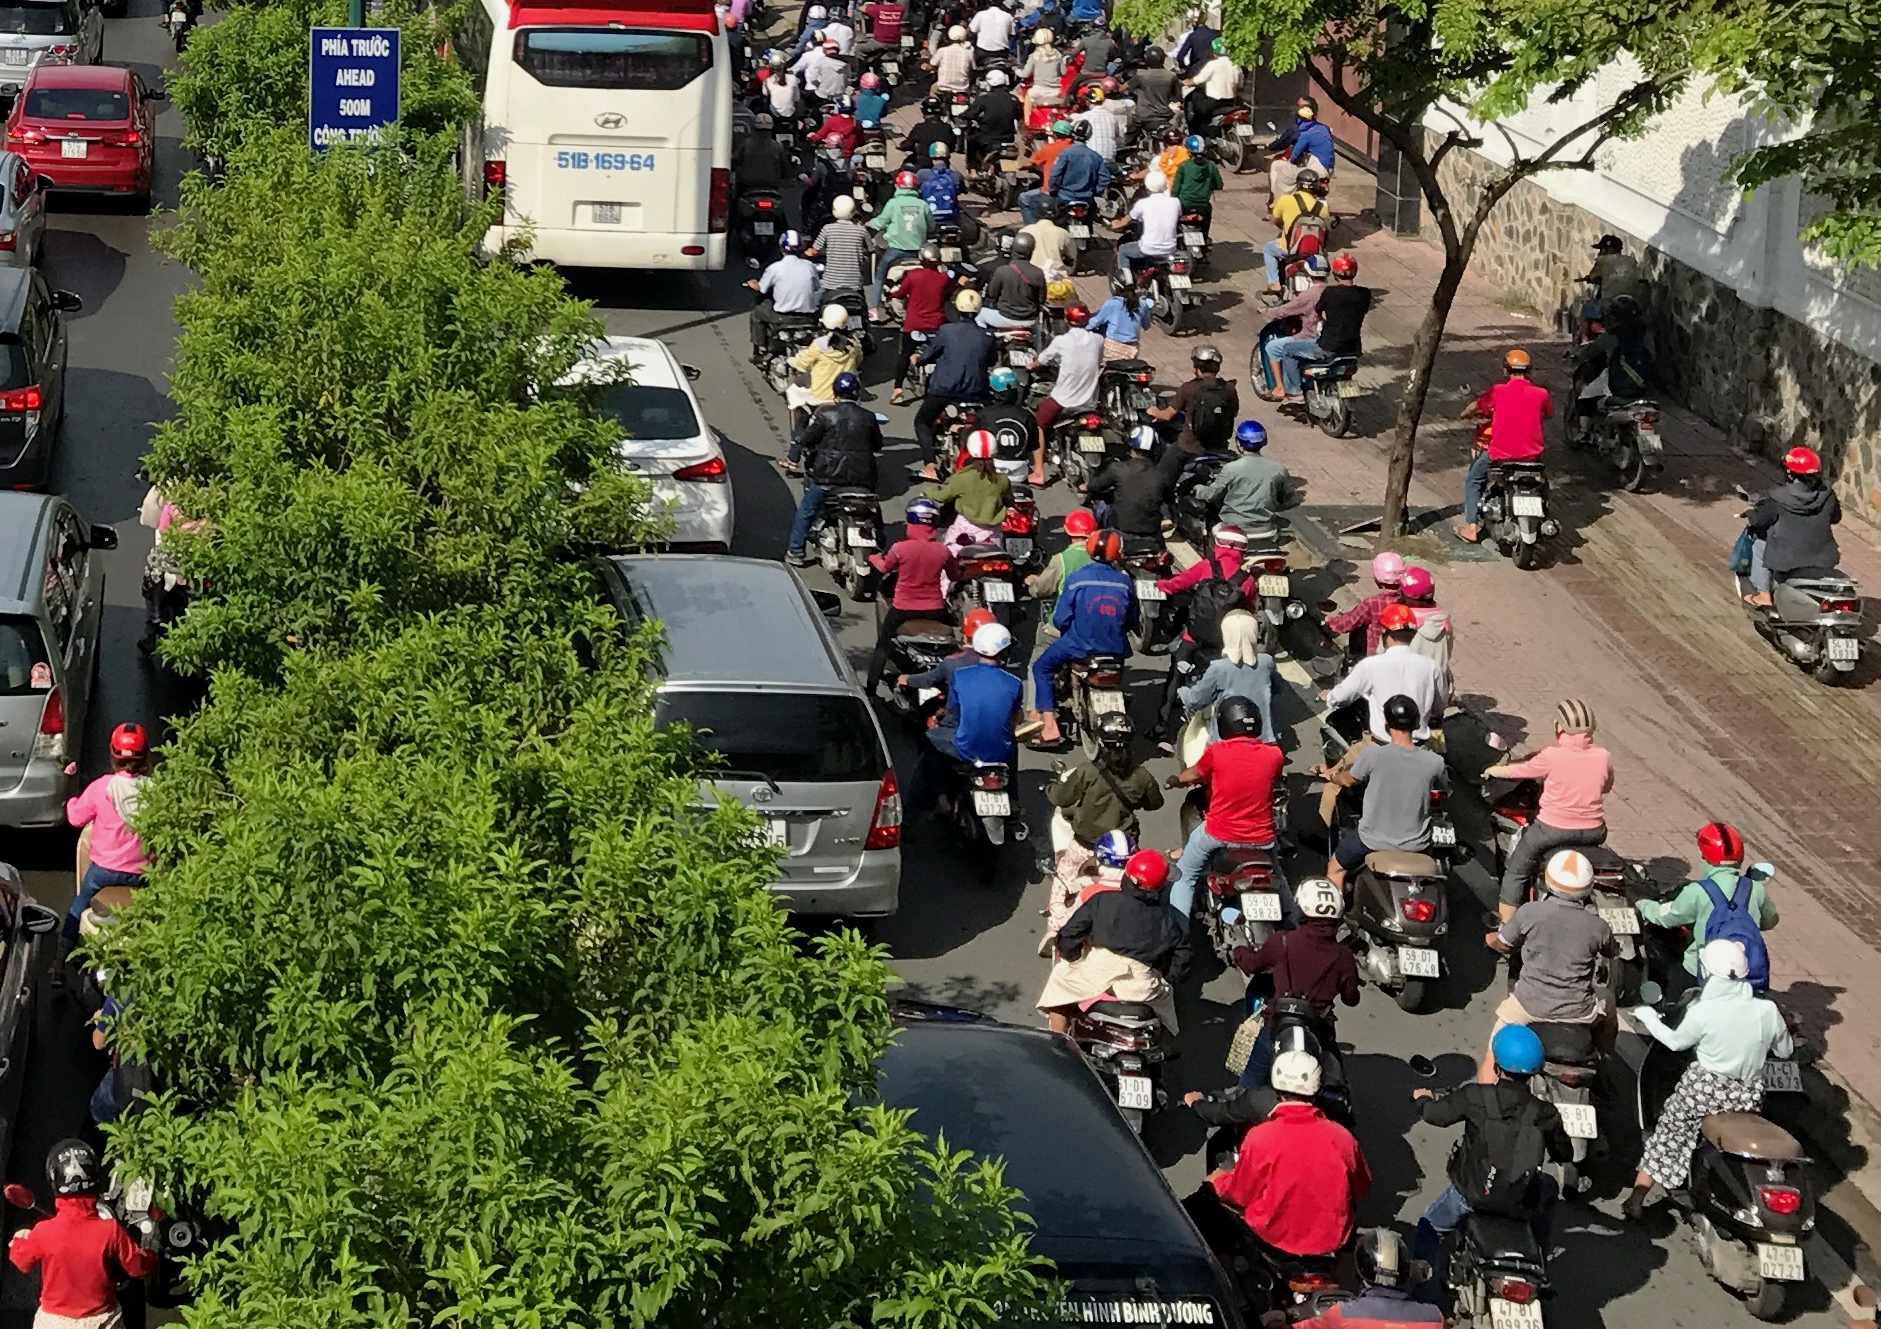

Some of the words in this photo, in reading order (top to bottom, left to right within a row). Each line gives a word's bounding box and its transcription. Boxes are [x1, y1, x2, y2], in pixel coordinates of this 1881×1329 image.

[321, 34, 348, 57] PHÍA
[351, 34, 390, 58] TRƯỚC
[336, 69, 374, 87] AHEAD
[339, 99, 371, 116] 500M
[1083, 1296, 1118, 1323] HÌNH
[1123, 1297, 1162, 1324] BÌNH
